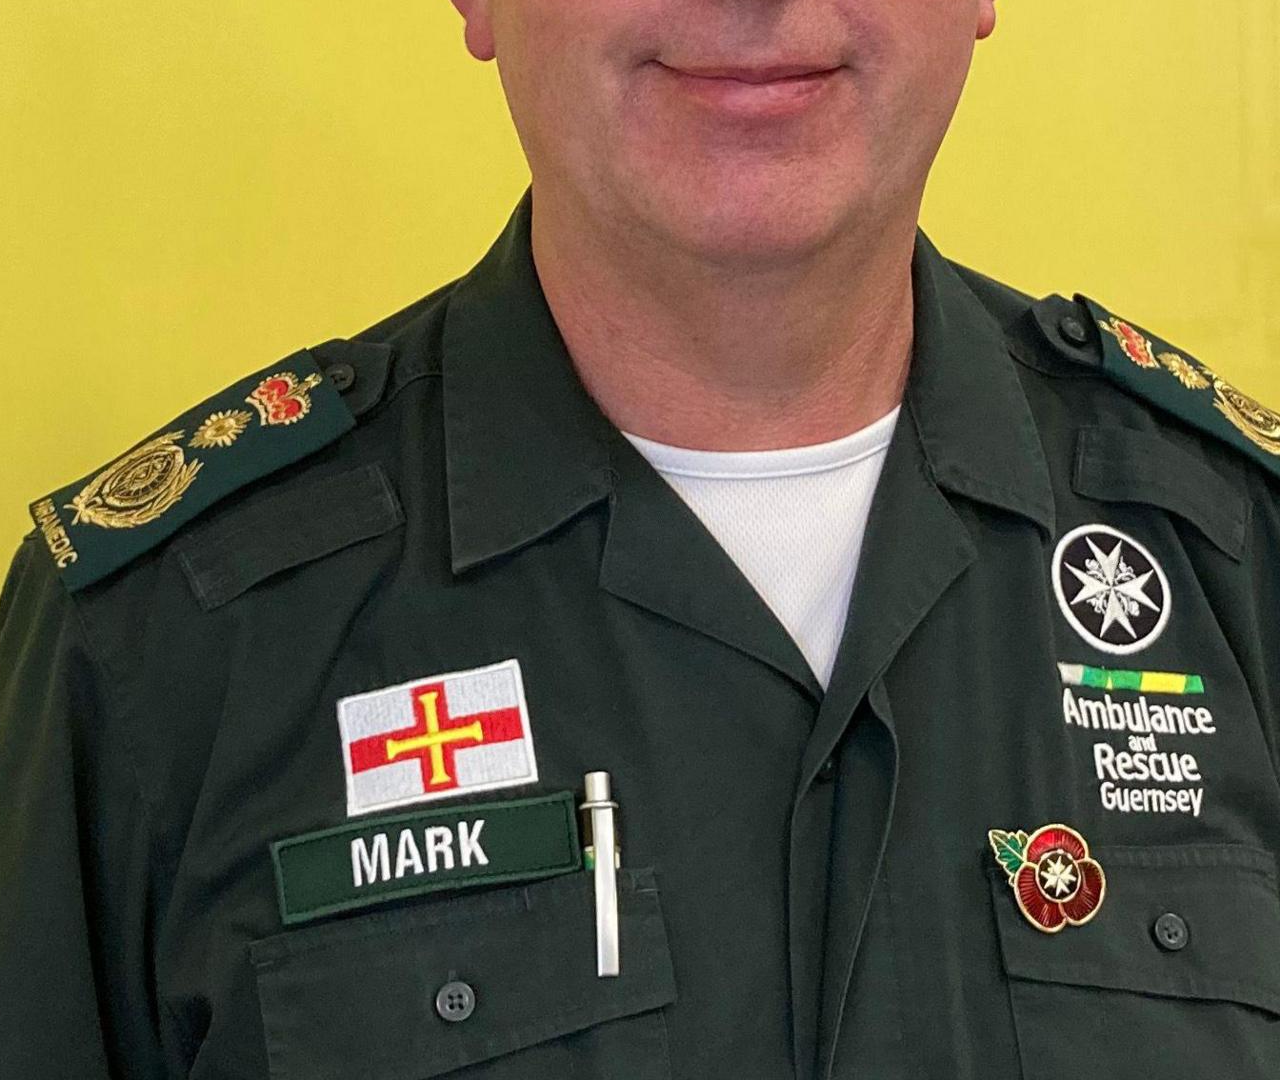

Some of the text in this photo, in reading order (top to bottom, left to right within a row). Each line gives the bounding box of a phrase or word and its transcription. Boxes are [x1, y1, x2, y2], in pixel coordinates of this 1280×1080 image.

[1062, 687, 1216, 735] Ambulance
[1093, 742, 1202, 782] Rescue
[1128, 732, 1158, 752] and
[1099, 781, 1204, 817] Guernsey
[350, 819, 490, 888] MARK
